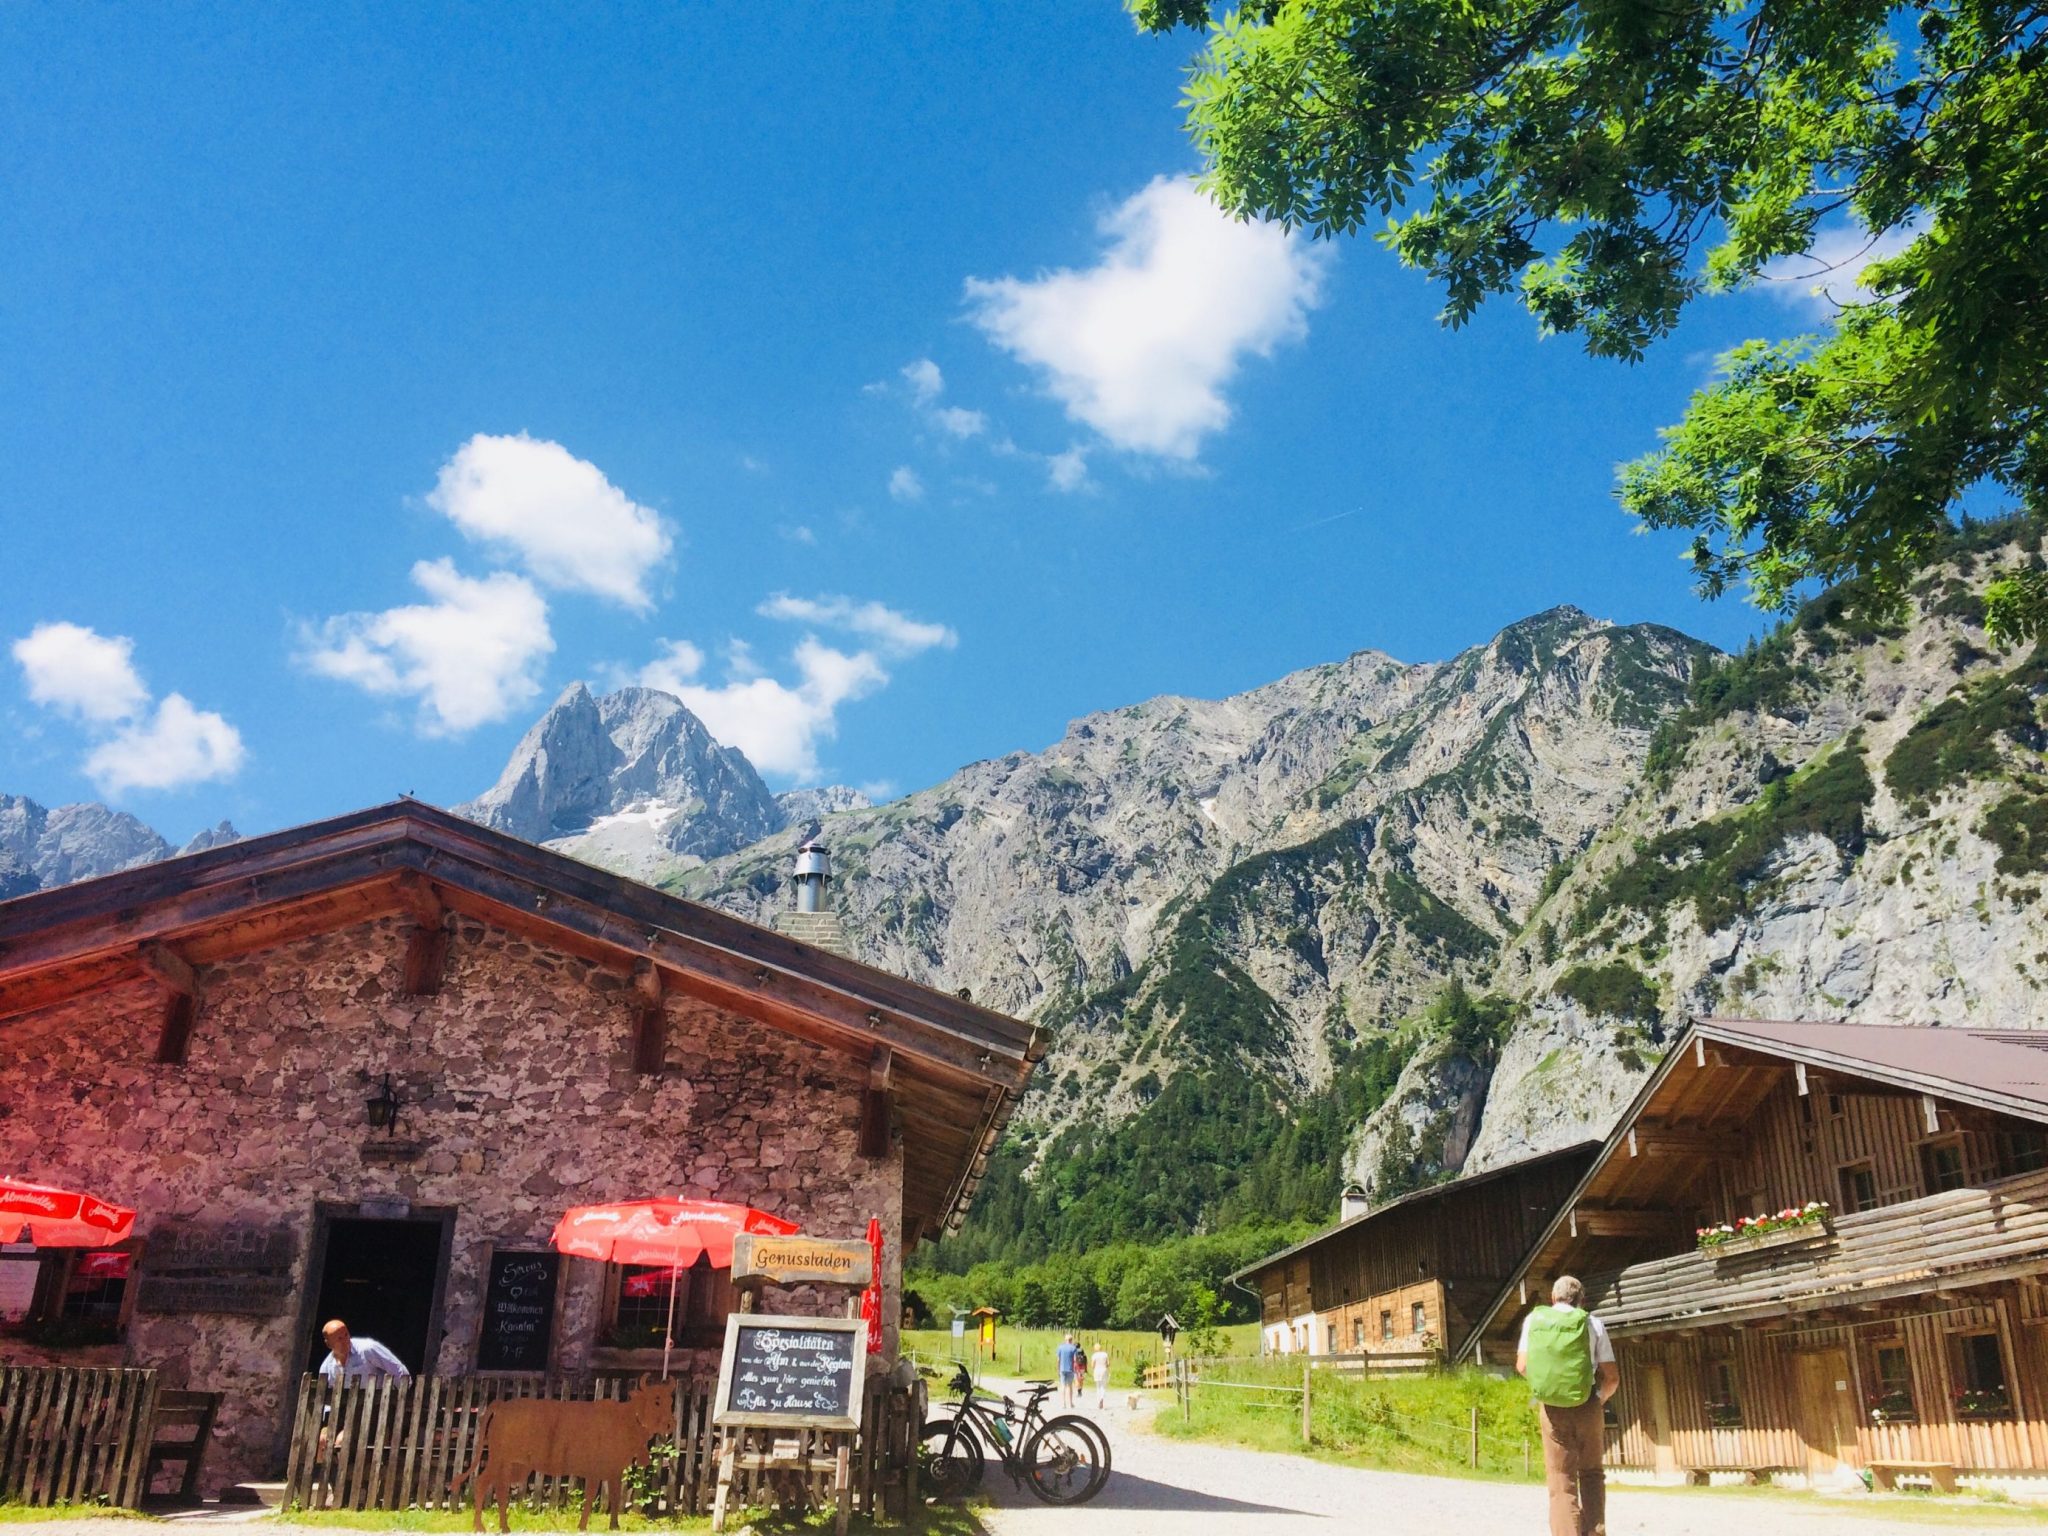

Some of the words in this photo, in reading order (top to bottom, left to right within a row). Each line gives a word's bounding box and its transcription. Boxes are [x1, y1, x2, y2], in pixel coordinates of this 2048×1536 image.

[755, 1248, 851, 1269] Genussladen
[753, 1330, 834, 1353] Spezialitäten
[815, 1351, 852, 1375] Region
[740, 1371, 759, 1383] Alles
[760, 1375, 780, 1386] zum
[782, 1373, 797, 1385] hier
[770, 1399, 782, 1411] zu
[783, 1394, 813, 1409] Hause
